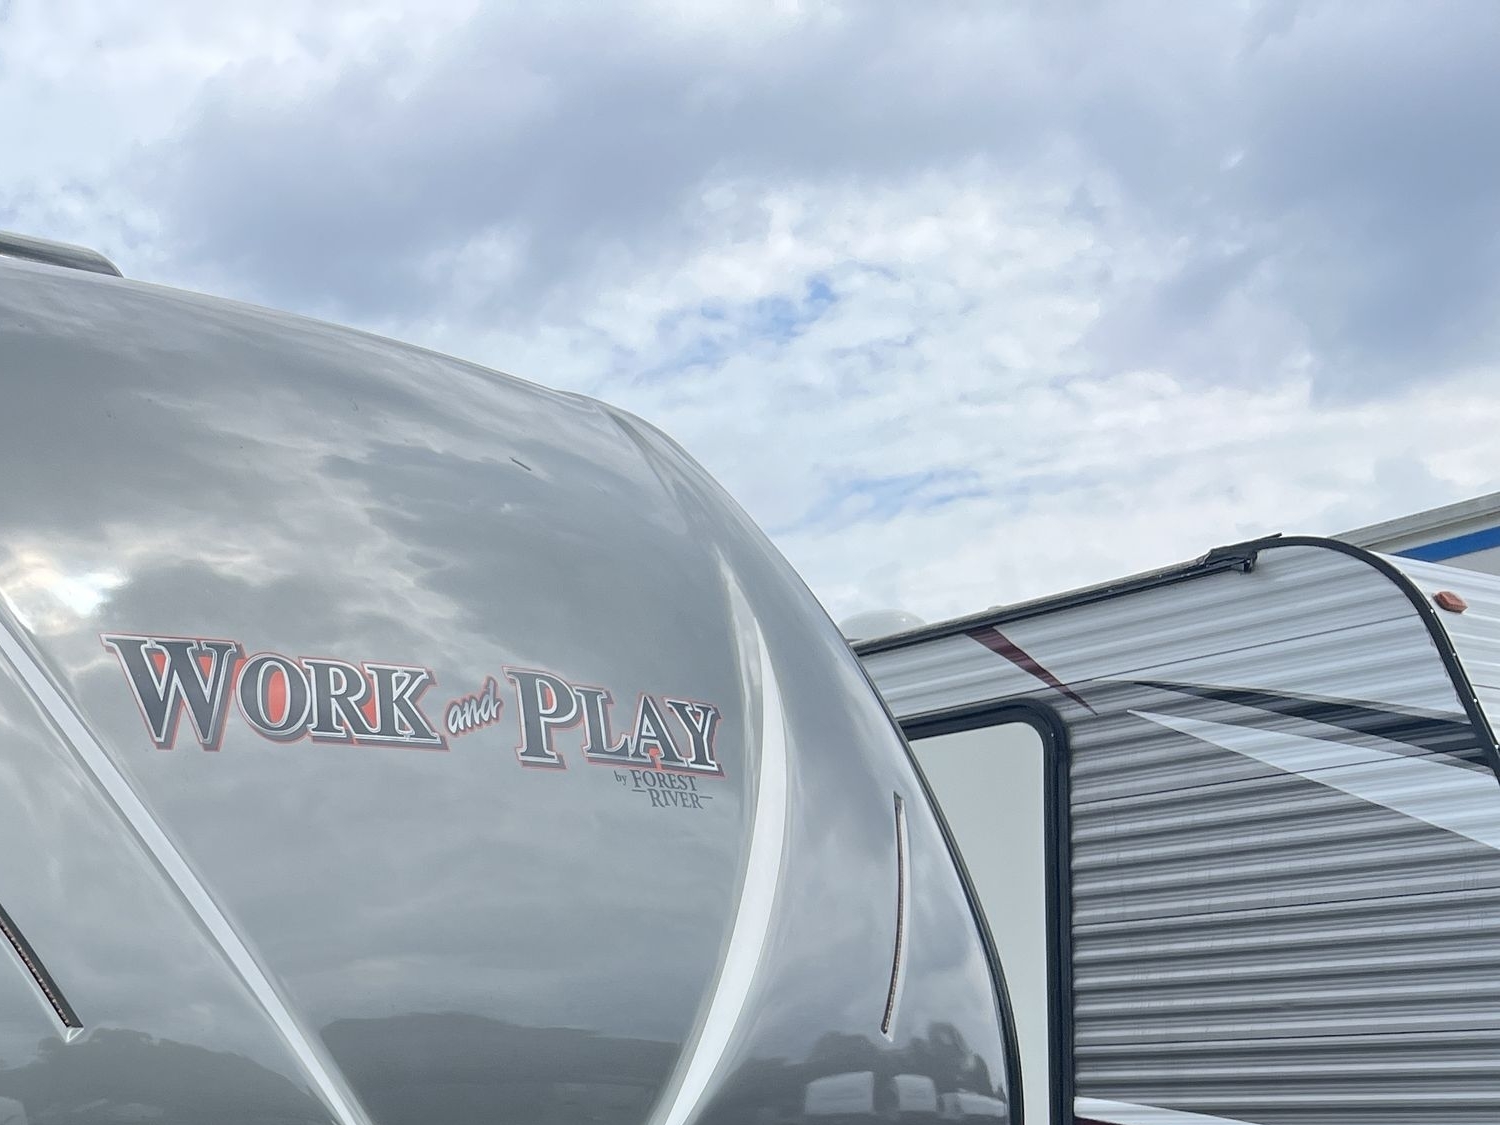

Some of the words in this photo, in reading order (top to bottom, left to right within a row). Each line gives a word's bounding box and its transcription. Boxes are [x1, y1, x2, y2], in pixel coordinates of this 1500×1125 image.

[100, 634, 448, 750] WORK
[444, 676, 503, 735] and
[502, 667, 724, 777] PLAY
[613, 769, 627, 786] by
[629, 769, 698, 792] FOREST
[647, 788, 704, 809] RIVER
